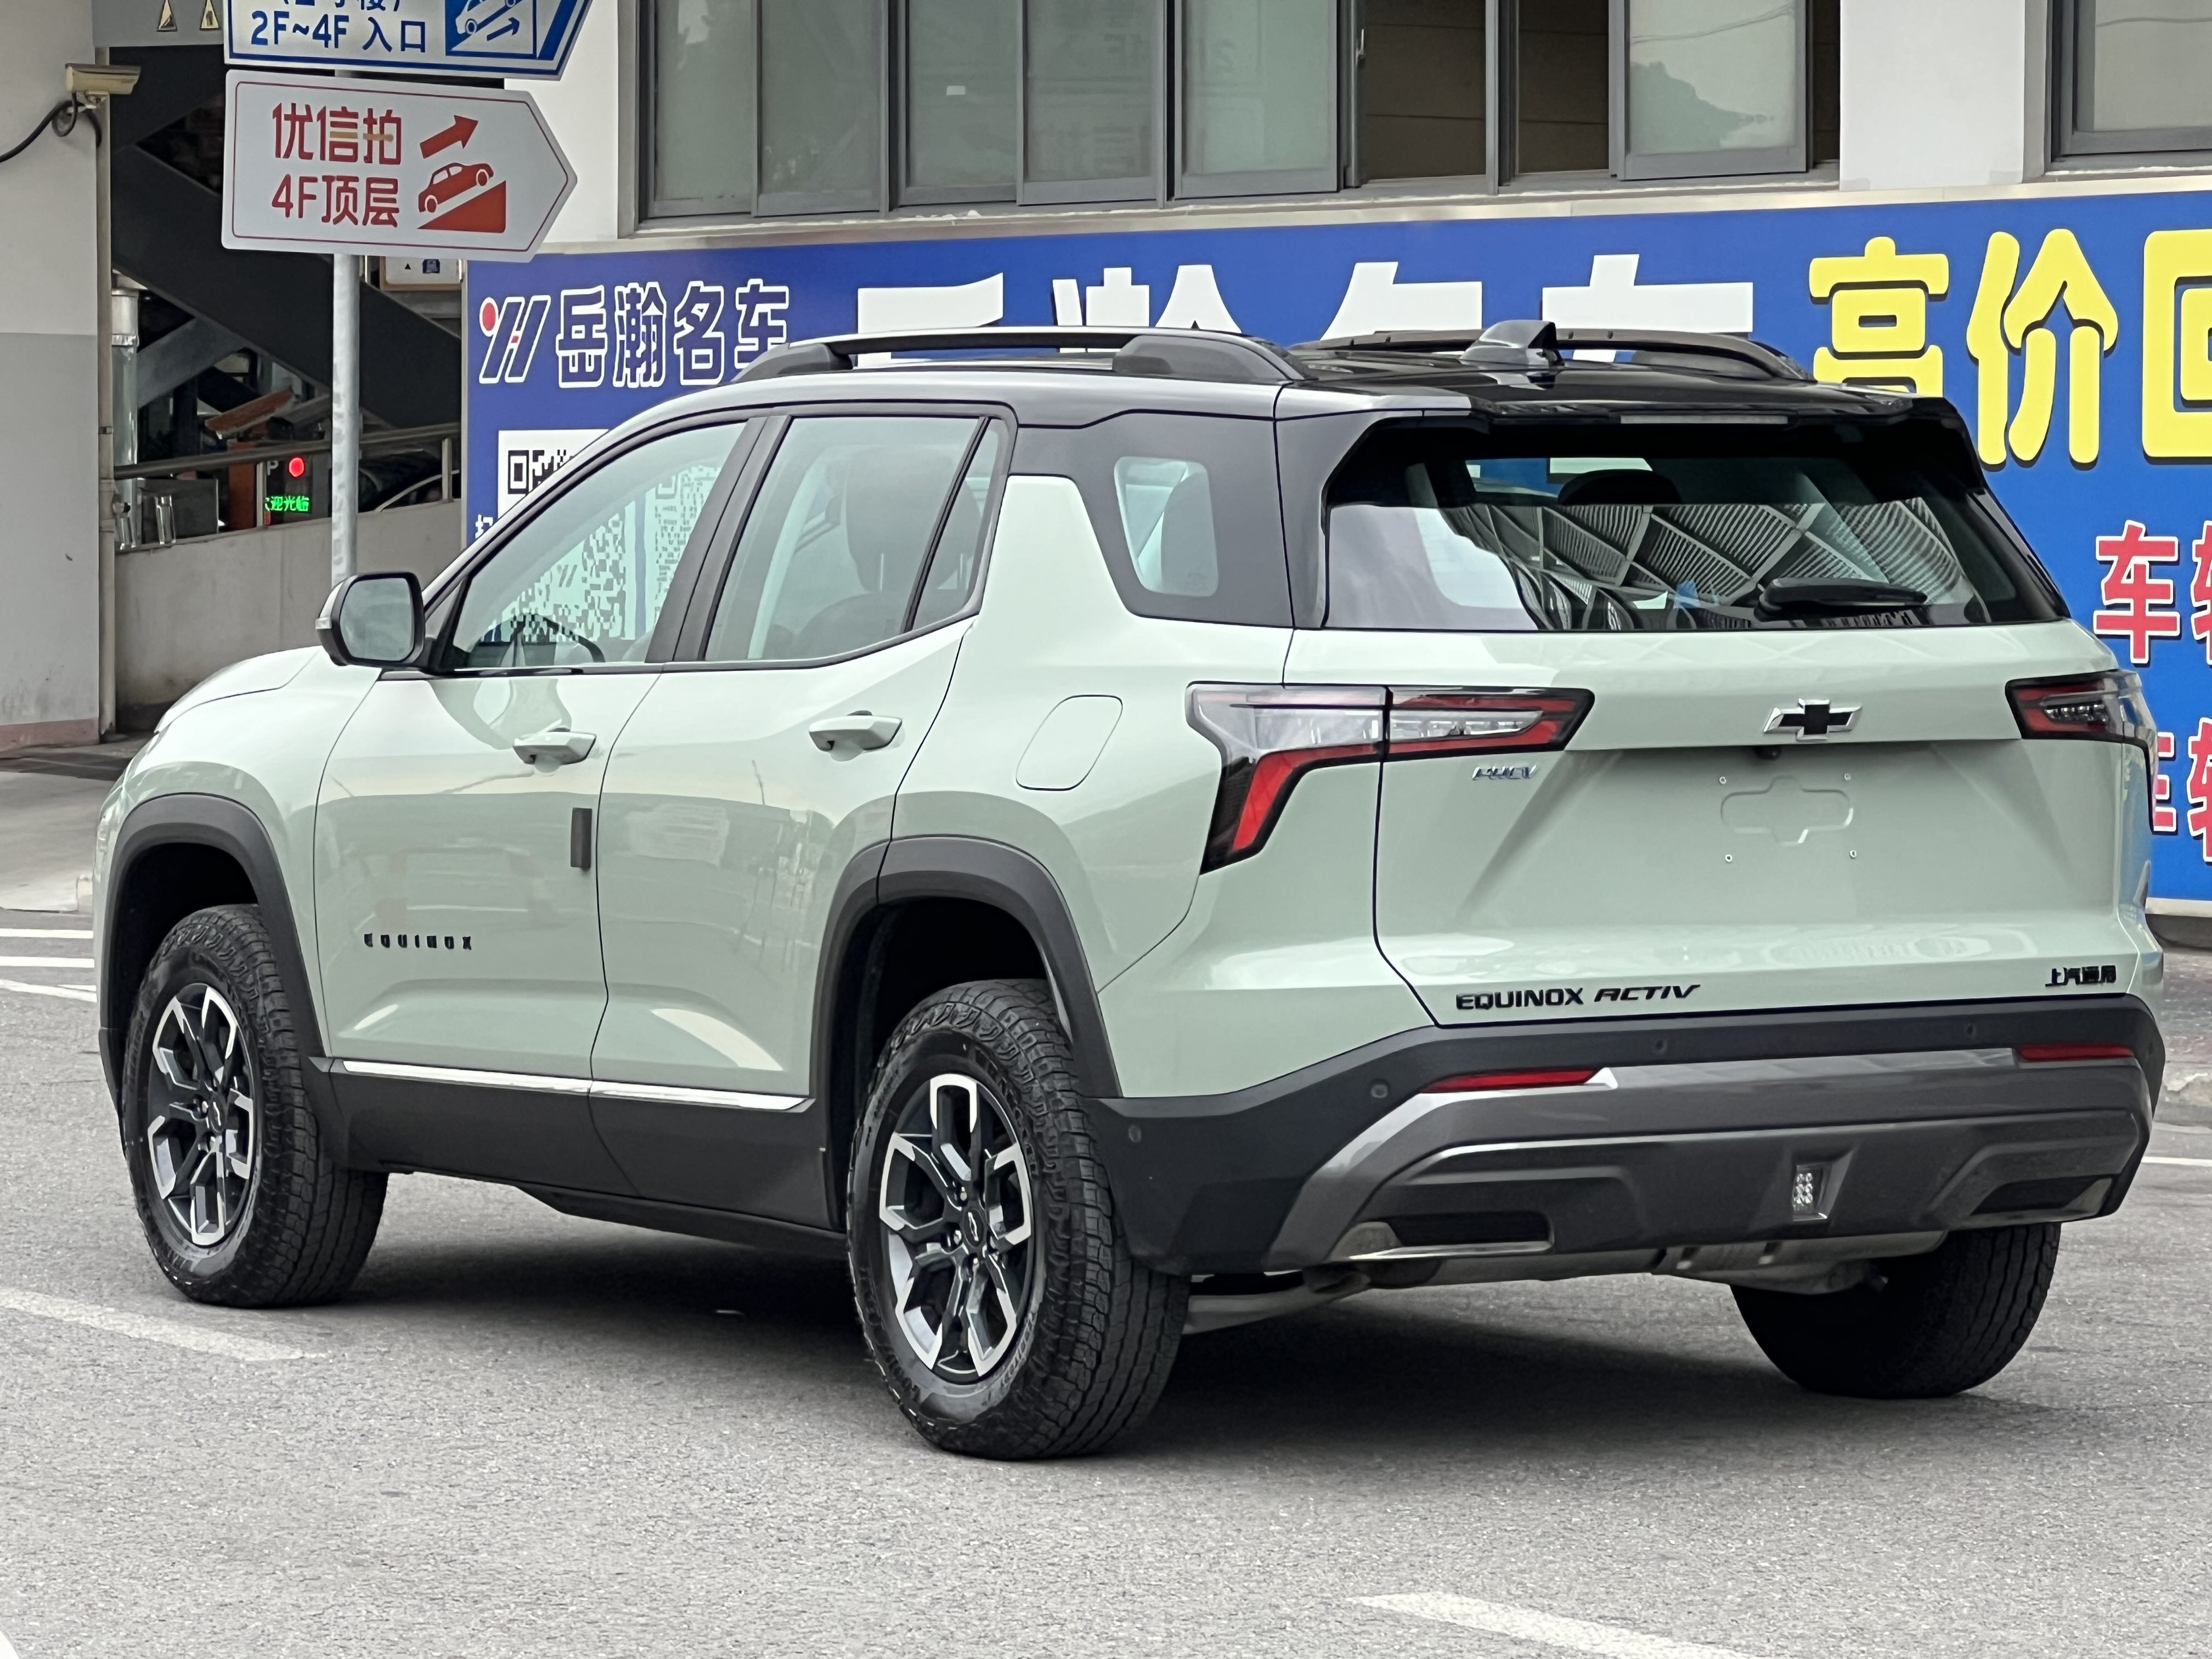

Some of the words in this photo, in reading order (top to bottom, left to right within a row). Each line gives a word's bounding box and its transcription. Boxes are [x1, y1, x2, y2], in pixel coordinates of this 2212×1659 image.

[251, 11, 349, 48] 2F~4F
[362, 16, 426, 53] 入口
[273, 103, 402, 165] 优信拍
[272, 174, 399, 227] 4F顶层
[556, 279, 789, 388] 岳瀚名车
[2093, 520, 2212, 665] 车
[1456, 987, 1584, 1010] EQUINOX
[1594, 984, 1701, 1003] ACTIV
